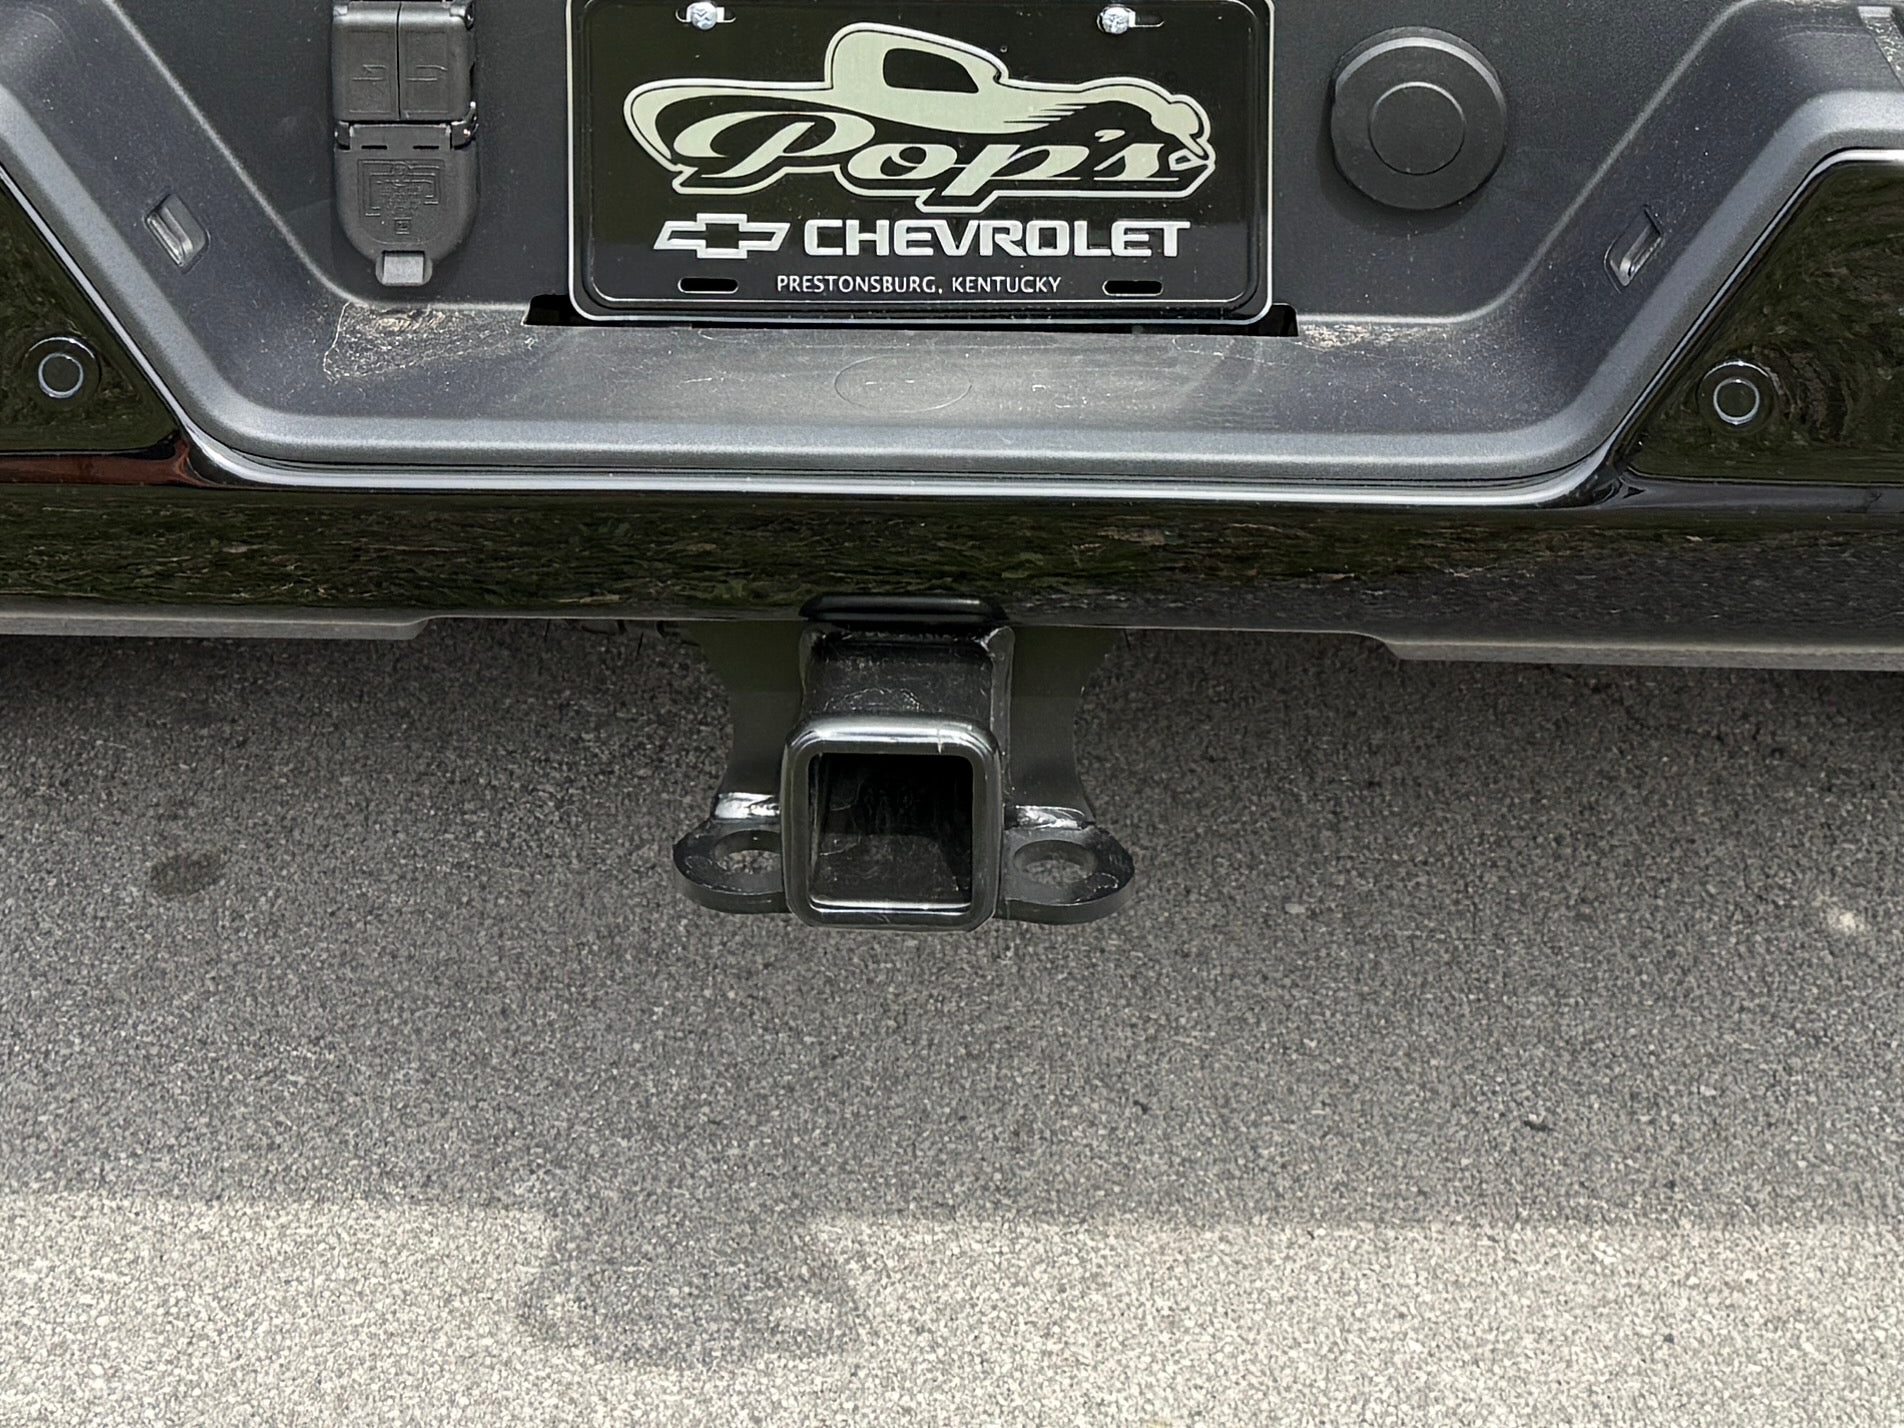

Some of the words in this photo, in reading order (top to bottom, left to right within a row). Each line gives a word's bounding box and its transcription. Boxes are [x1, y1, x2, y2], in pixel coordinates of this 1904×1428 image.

[672, 111, 1179, 196] Pop's
[804, 219, 1191, 257] CHEVROLET
[777, 275, 943, 295] PRESTONSBURG,
[952, 275, 1062, 294] KENTUCKY
